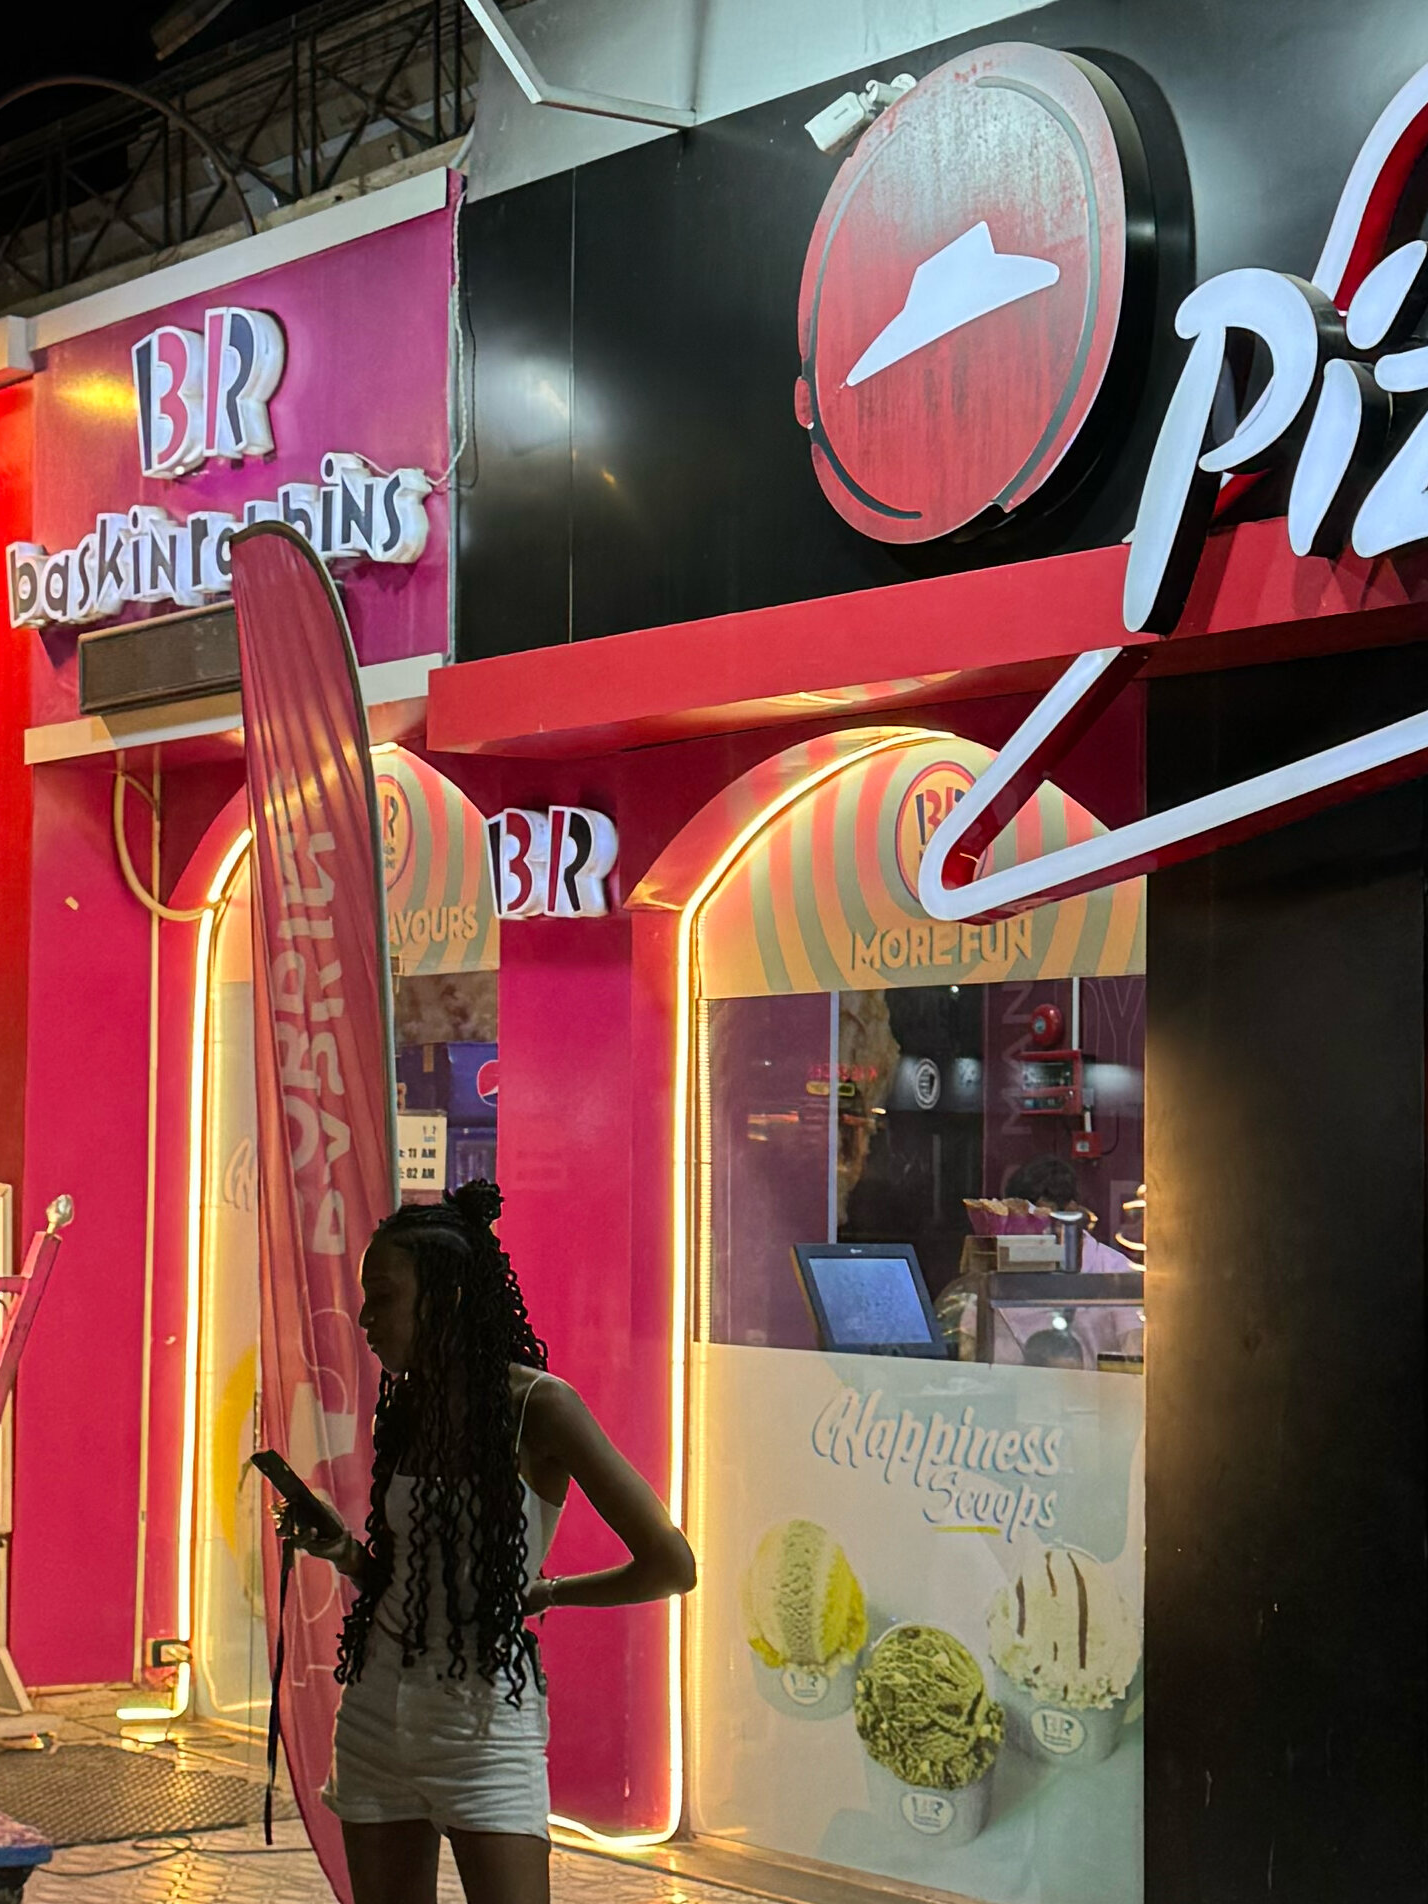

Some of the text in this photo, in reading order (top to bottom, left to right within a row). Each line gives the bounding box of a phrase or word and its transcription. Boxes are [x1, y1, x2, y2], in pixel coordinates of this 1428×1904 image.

[132, 307, 285, 478] BR
[488, 805, 619, 920] BR
[387, 903, 479, 946] AVOURS
[851, 910, 1033, 972] MORE FUN
[813, 1386, 1063, 1487] Happiness
[923, 1462, 1059, 1543] Scoops
